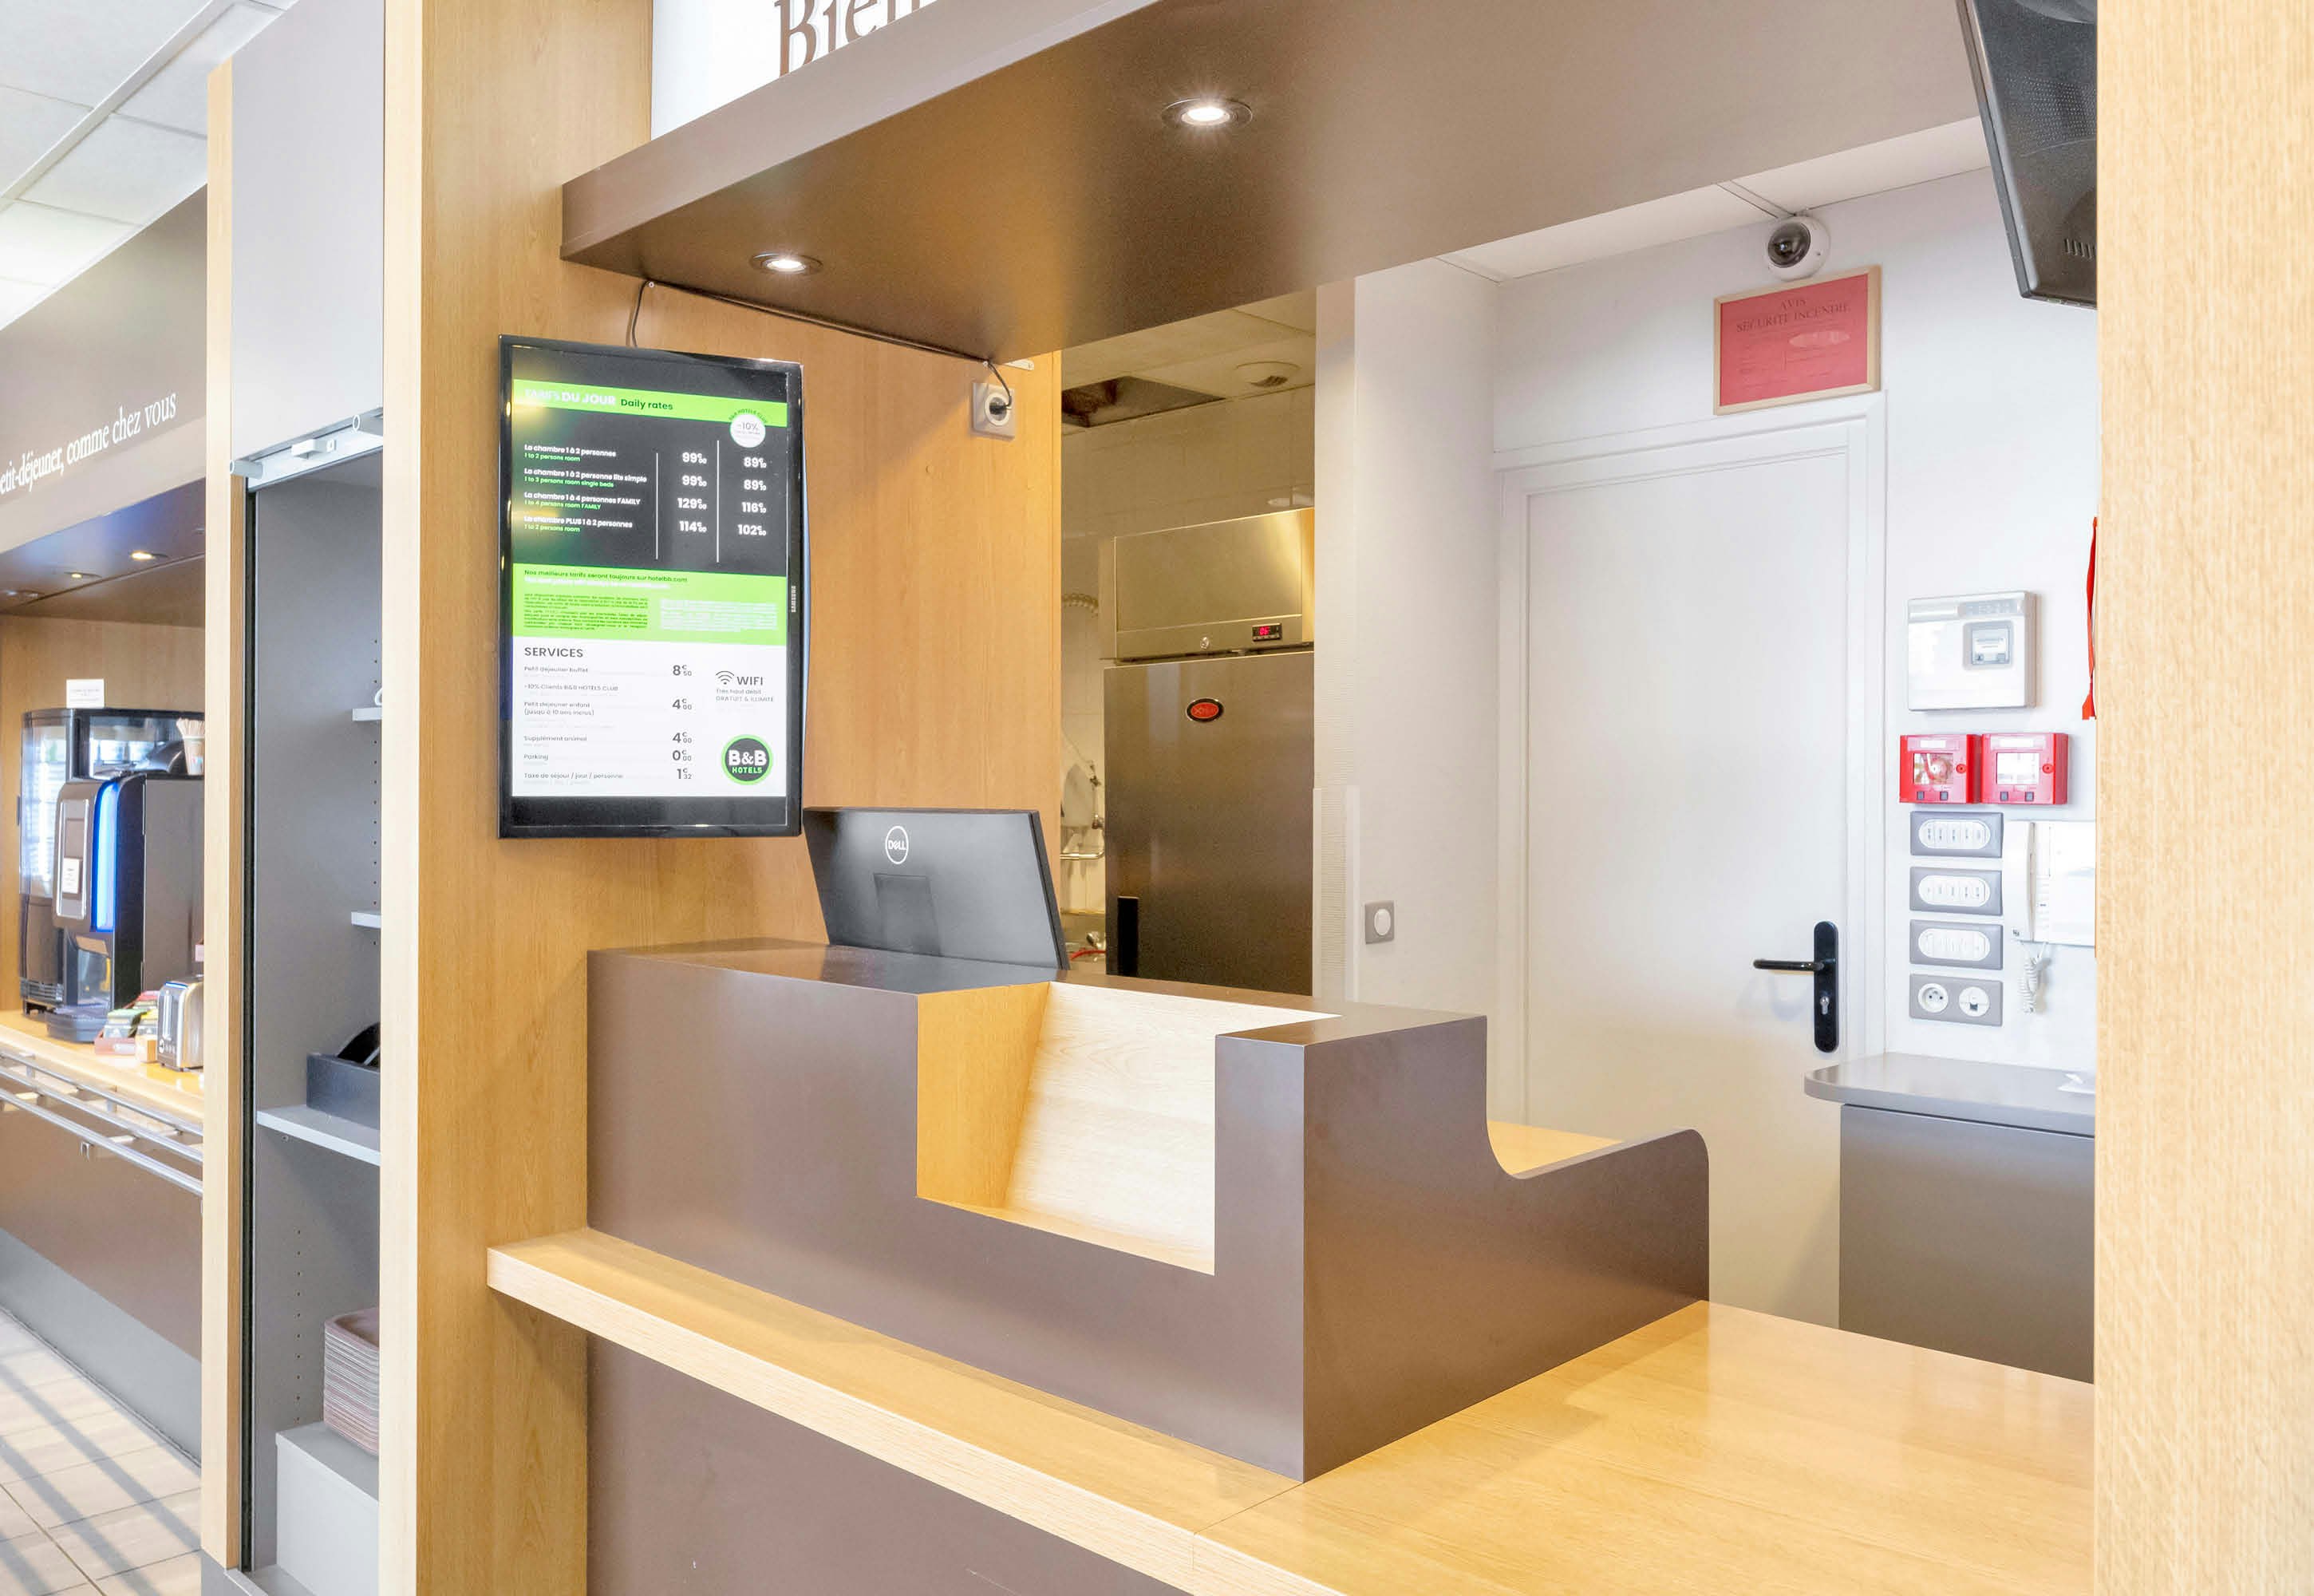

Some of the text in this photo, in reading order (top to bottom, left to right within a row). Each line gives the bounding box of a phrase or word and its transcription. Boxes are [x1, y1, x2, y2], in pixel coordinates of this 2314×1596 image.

[562, 391, 580, 403] DU
[582, 393, 616, 405] JOUR
[621, 398, 646, 410] Daily
[648, 401, 673, 410] rates
[67, 425, 109, 465] comme
[113, 405, 140, 444] chez
[144, 393, 176, 429] vous
[534, 444, 565, 453] chambre
[581, 448, 617, 457] personnes
[533, 468, 565, 477] chambre
[581, 496, 616, 504] personnes
[524, 646, 584, 658] SERVICES
[736, 676, 763, 685] WIFI
[523, 753, 549, 761] Parking
[728, 749, 767, 766] B&B
[887, 839, 907, 851] DELL
